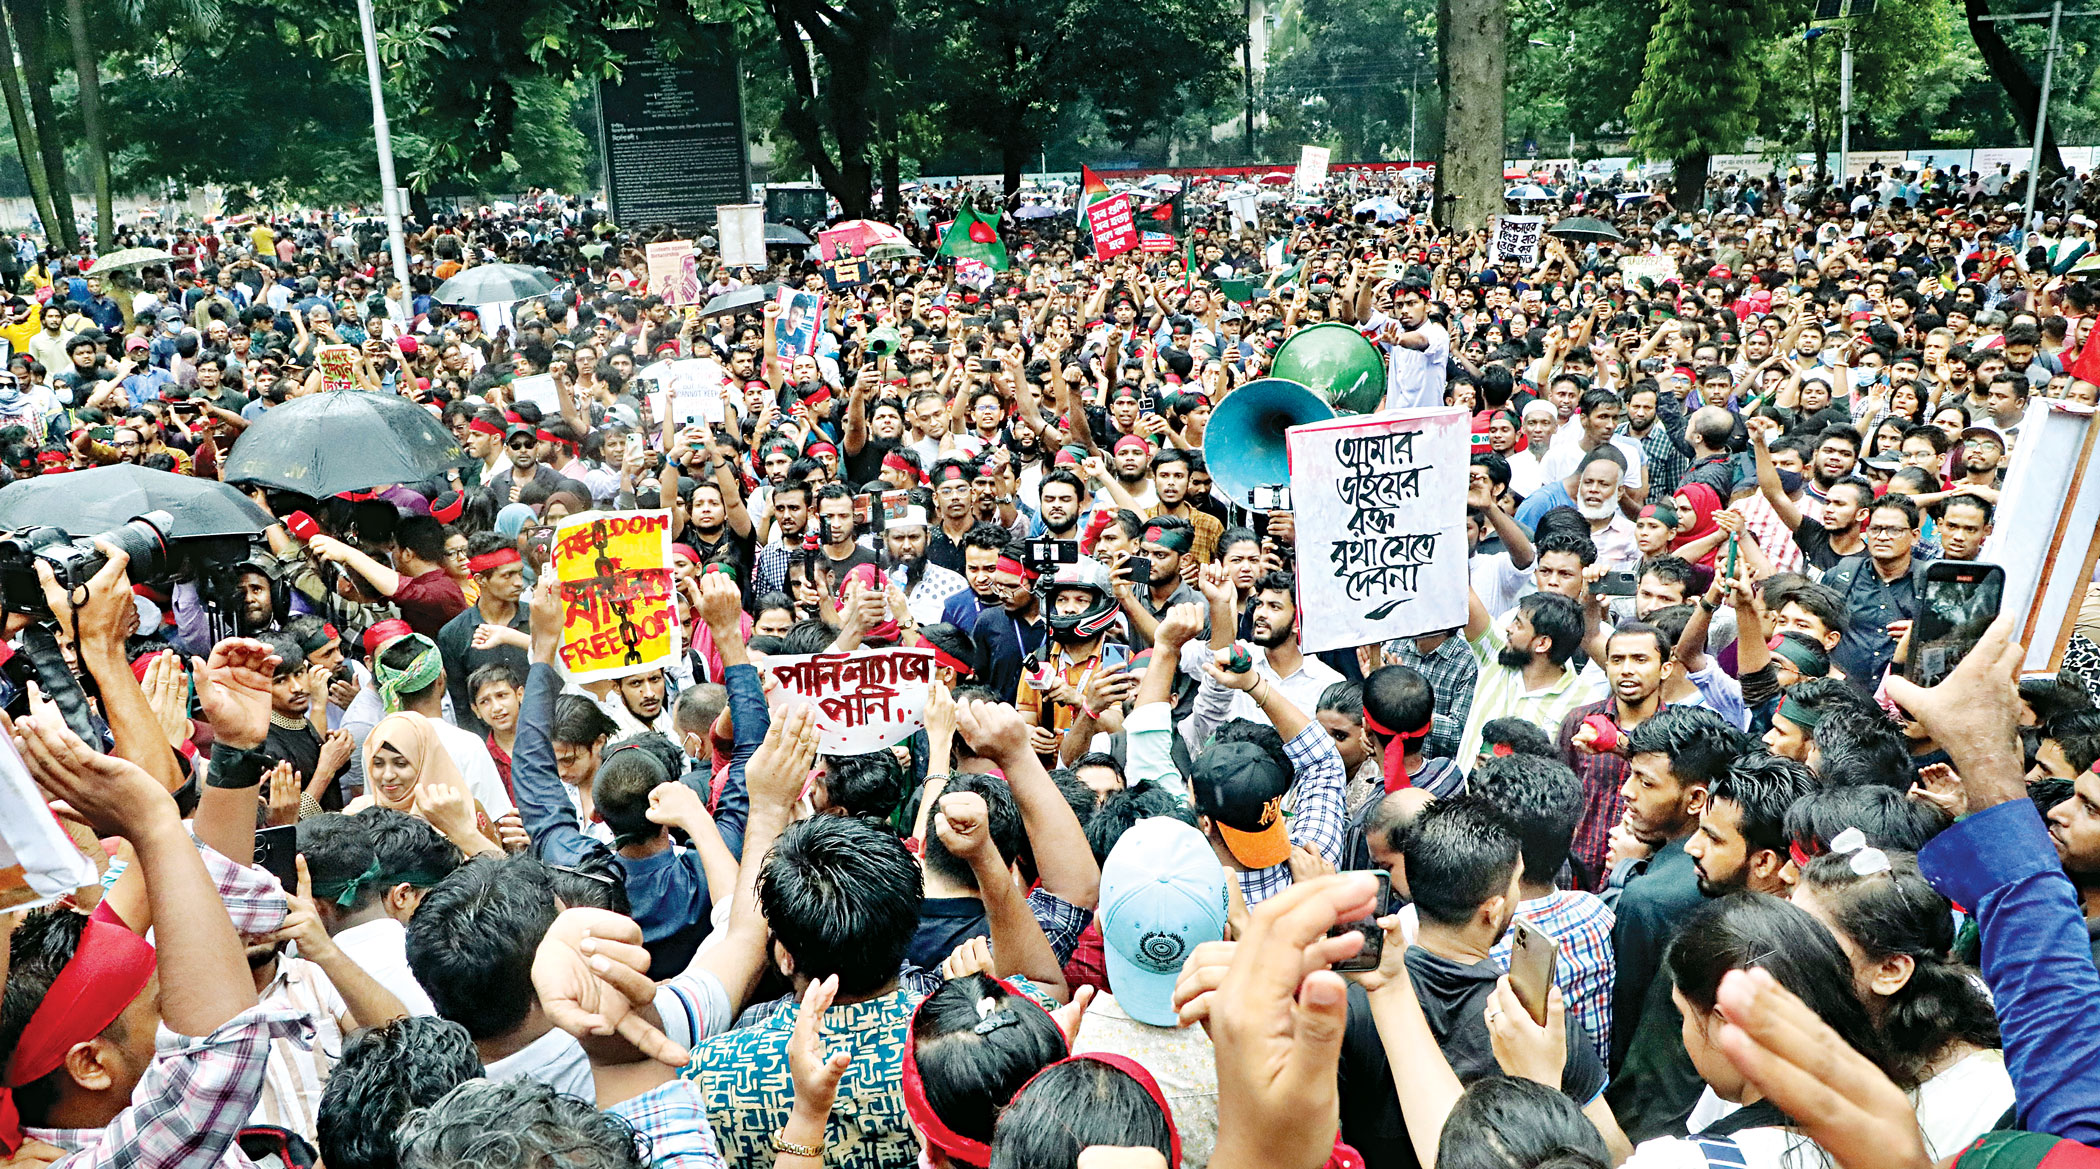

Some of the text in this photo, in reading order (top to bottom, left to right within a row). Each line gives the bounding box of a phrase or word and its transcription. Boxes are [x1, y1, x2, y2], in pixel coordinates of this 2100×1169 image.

[1336, 430, 1423, 467] আমার
[559, 604, 680, 669] FREEDOM
[818, 685, 900, 727] পানি
